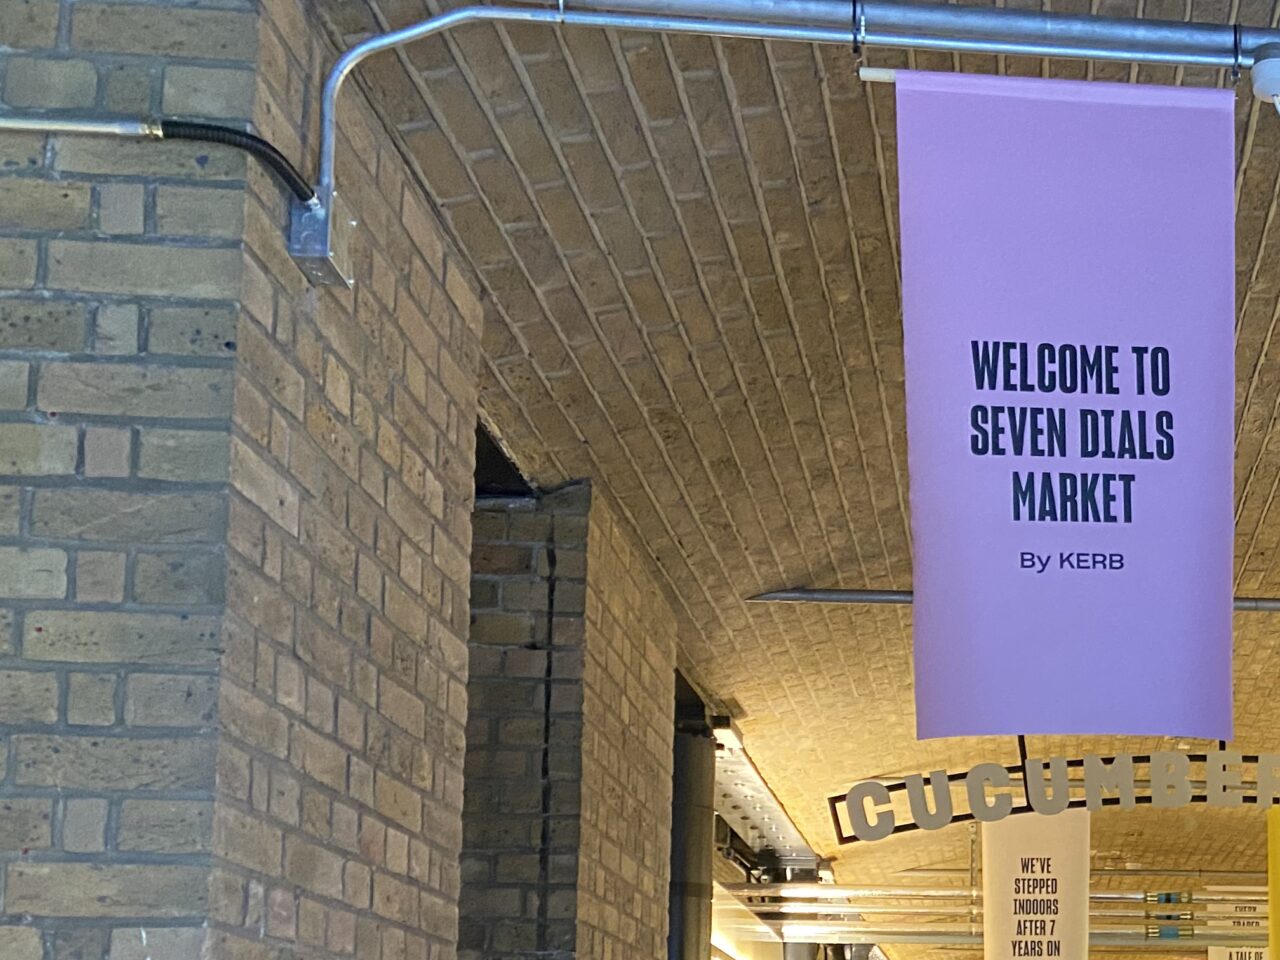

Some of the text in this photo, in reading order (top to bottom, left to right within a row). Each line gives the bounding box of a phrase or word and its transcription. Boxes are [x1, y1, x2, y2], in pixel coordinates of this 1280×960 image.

[970, 340, 1171, 397] WELCOME TO
[970, 404, 1175, 461] SEVEN DIALS
[1012, 471, 1136, 524] MARKET
[1020, 552, 1125, 574] By KERB
[1020, 857, 1052, 874] WE'VE
[1014, 878, 1058, 895] STEPPED
[1013, 898, 1059, 916] INDOORS
[1016, 919, 1056, 936] AFTER 7
[1011, 940, 1060, 957] YEARS ON
